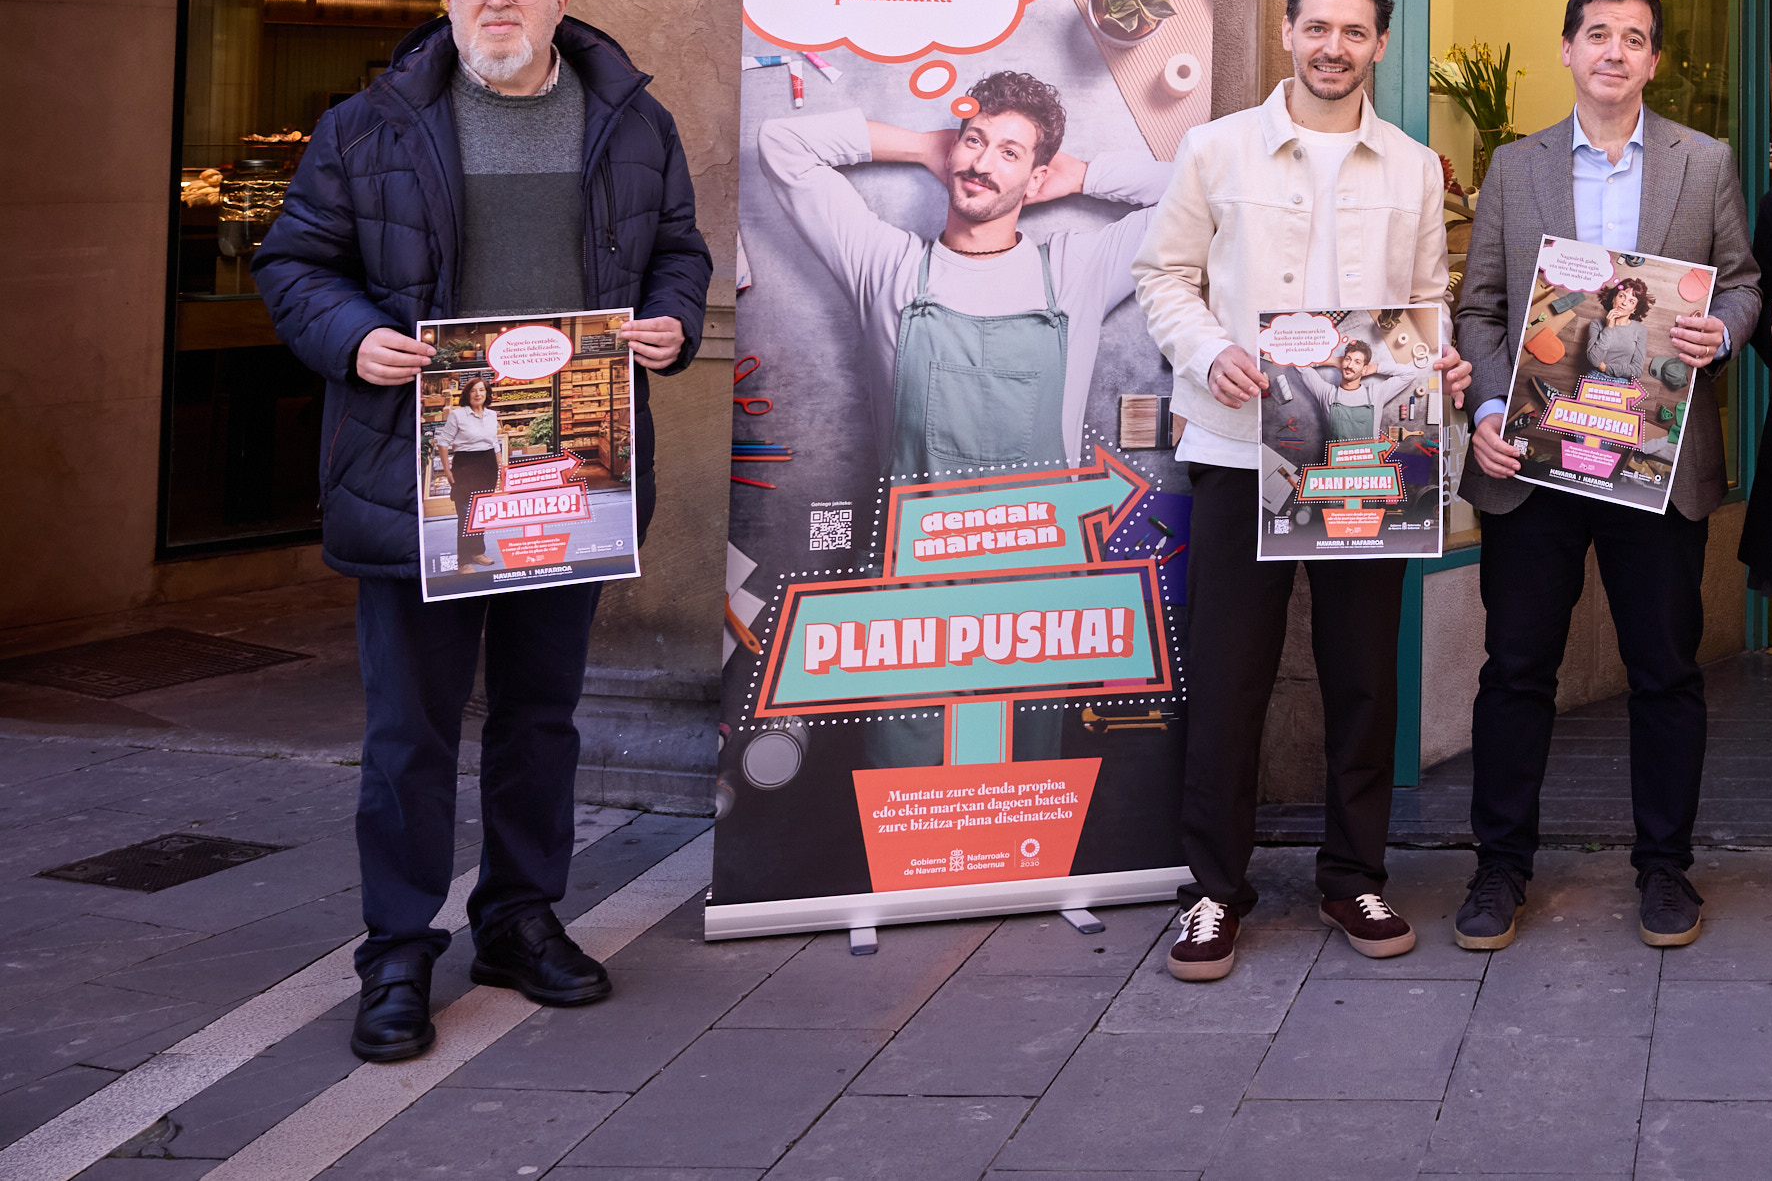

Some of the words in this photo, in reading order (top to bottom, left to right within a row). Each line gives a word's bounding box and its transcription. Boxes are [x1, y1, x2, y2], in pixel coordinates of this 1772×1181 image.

[1554, 407, 1588, 425] PLAN
[1588, 414, 1635, 437] PUSKA!
[1309, 477, 1343, 490] PLAN
[1345, 476, 1392, 490] PUSKA!
[478, 494, 577, 522] ¡PLANAZO!
[920, 502, 1050, 533] dendak
[914, 525, 1058, 557] martxan
[805, 617, 938, 671] PLAN
[949, 607, 1127, 663] PUSKA!
[887, 788, 943, 803] Muntatu
[946, 787, 975, 798] zure
[978, 782, 1015, 796] denda
[1018, 779, 1066, 795] propioa
[873, 806, 896, 818] edo
[898, 802, 927, 816] ekin
[930, 799, 985, 814] martxan
[987, 796, 1032, 812] dagoen
[1035, 792, 1078, 806] batetik
[878, 821, 907, 833] zure
[911, 815, 992, 831] bizitza-plana
[994, 808, 1073, 824] diseinatzeko
[910, 857, 946, 867] Gobierno
[966, 861, 1005, 871] Gobernua
[967, 851, 1010, 862] Nafarroako
[903, 868, 914, 876] de
[916, 866, 946, 875] Navarra
